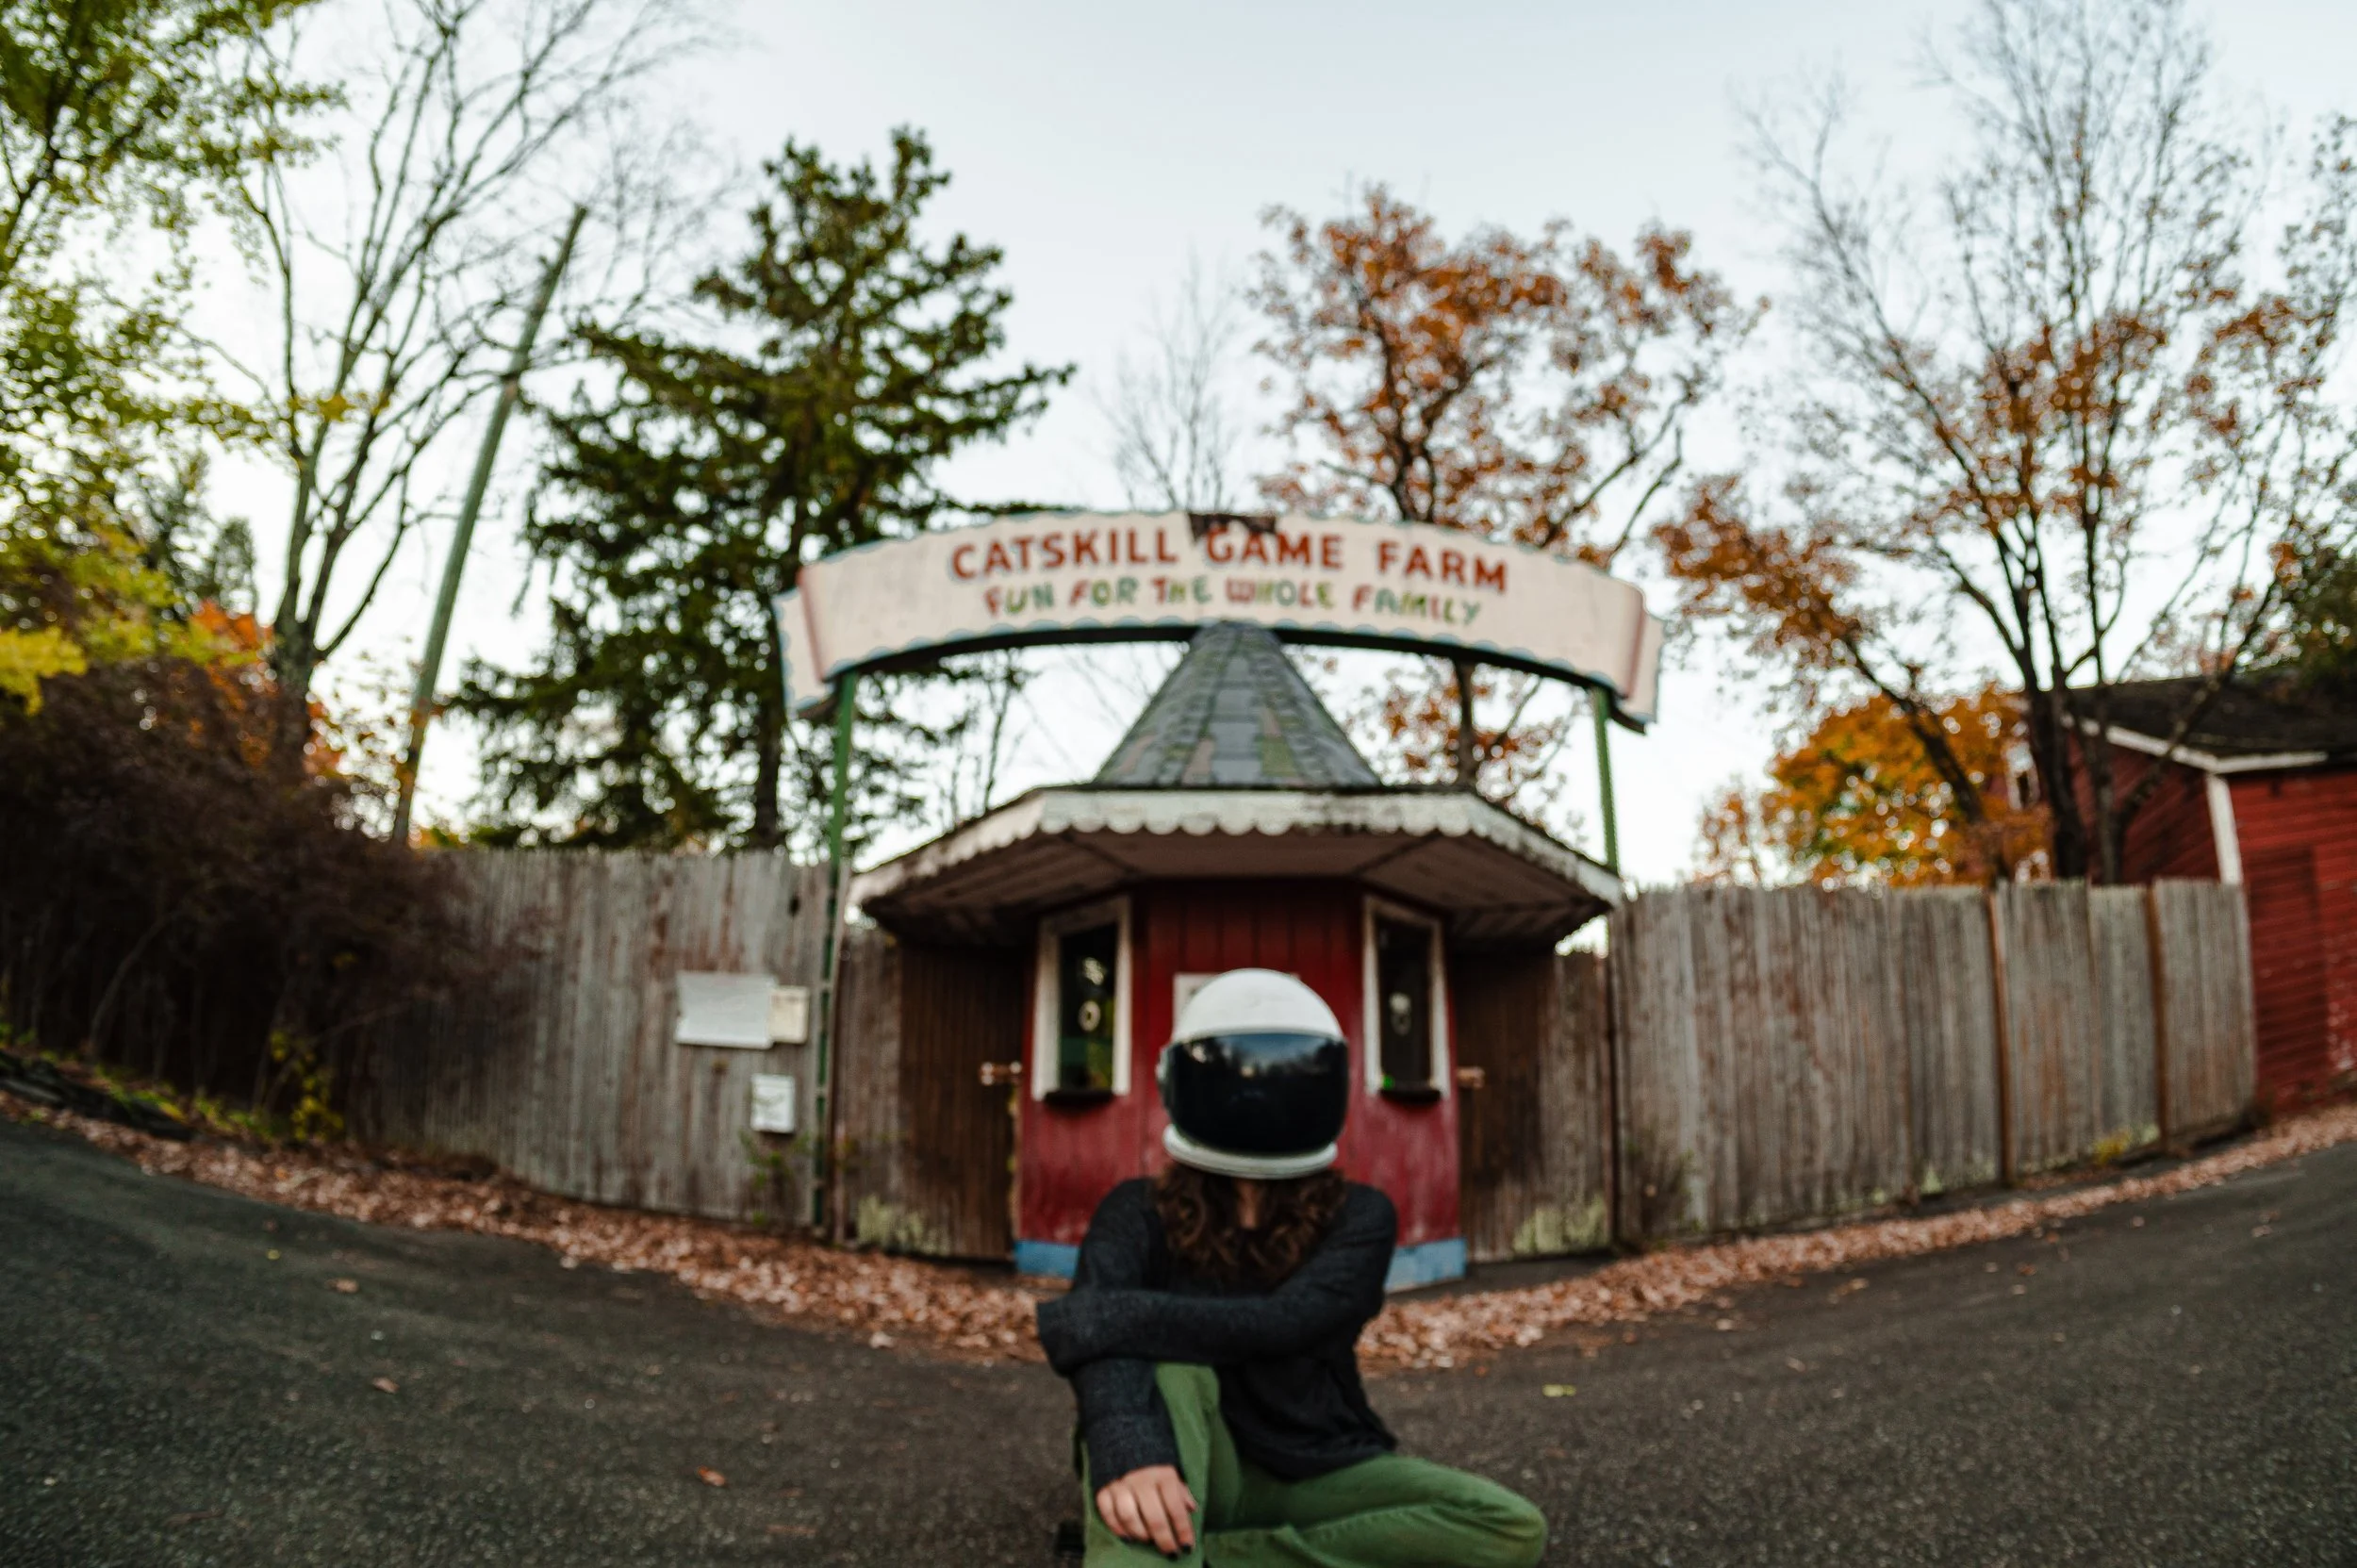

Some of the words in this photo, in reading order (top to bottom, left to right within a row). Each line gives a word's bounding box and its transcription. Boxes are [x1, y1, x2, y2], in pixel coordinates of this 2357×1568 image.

[951, 526, 1178, 579] CATSKILL
[1207, 522, 1343, 569] GAME
[1377, 540, 1507, 593] FARM
[984, 583, 1054, 616] FUN
[1069, 576, 1138, 606] FOR
[1152, 576, 1211, 604] THE
[1226, 576, 1334, 609] WHOLE
[1352, 584, 1481, 625] FAMILY
